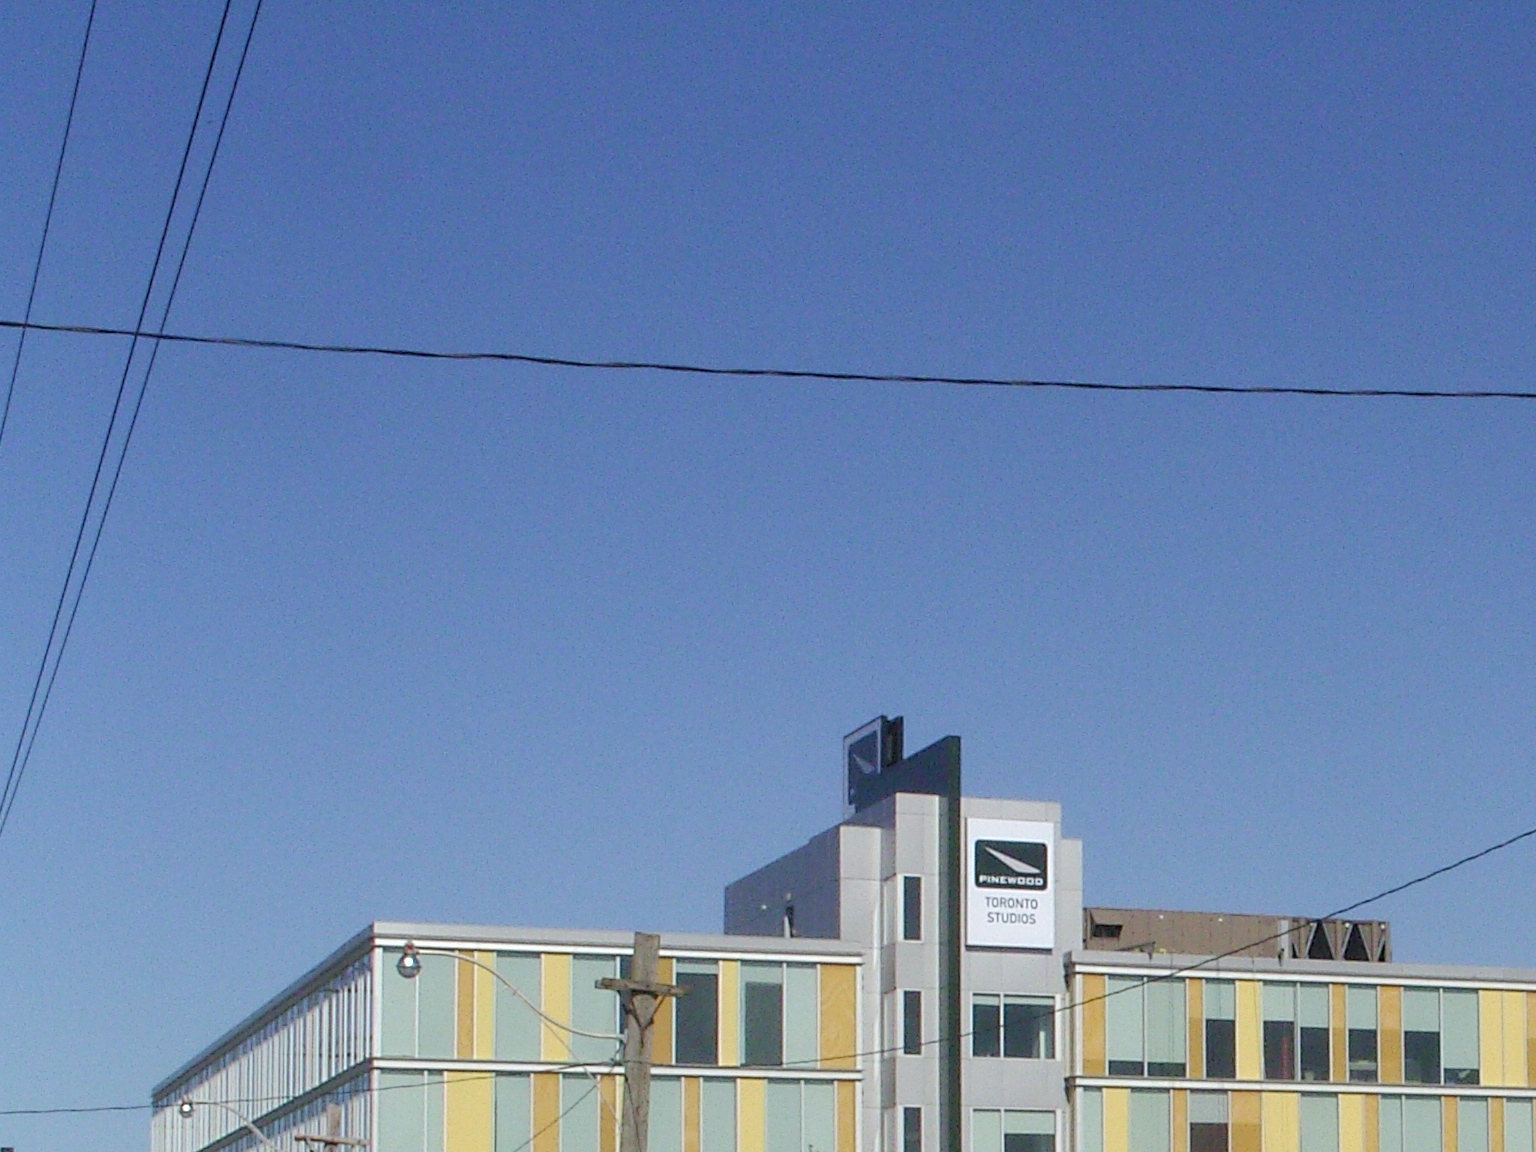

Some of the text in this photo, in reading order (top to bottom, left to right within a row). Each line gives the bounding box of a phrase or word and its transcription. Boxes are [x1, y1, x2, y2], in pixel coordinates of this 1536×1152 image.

[979, 875, 1044, 886] PINEWOOD
[985, 897, 1038, 910] TORONTO
[987, 912, 1036, 925] STUDIOS
